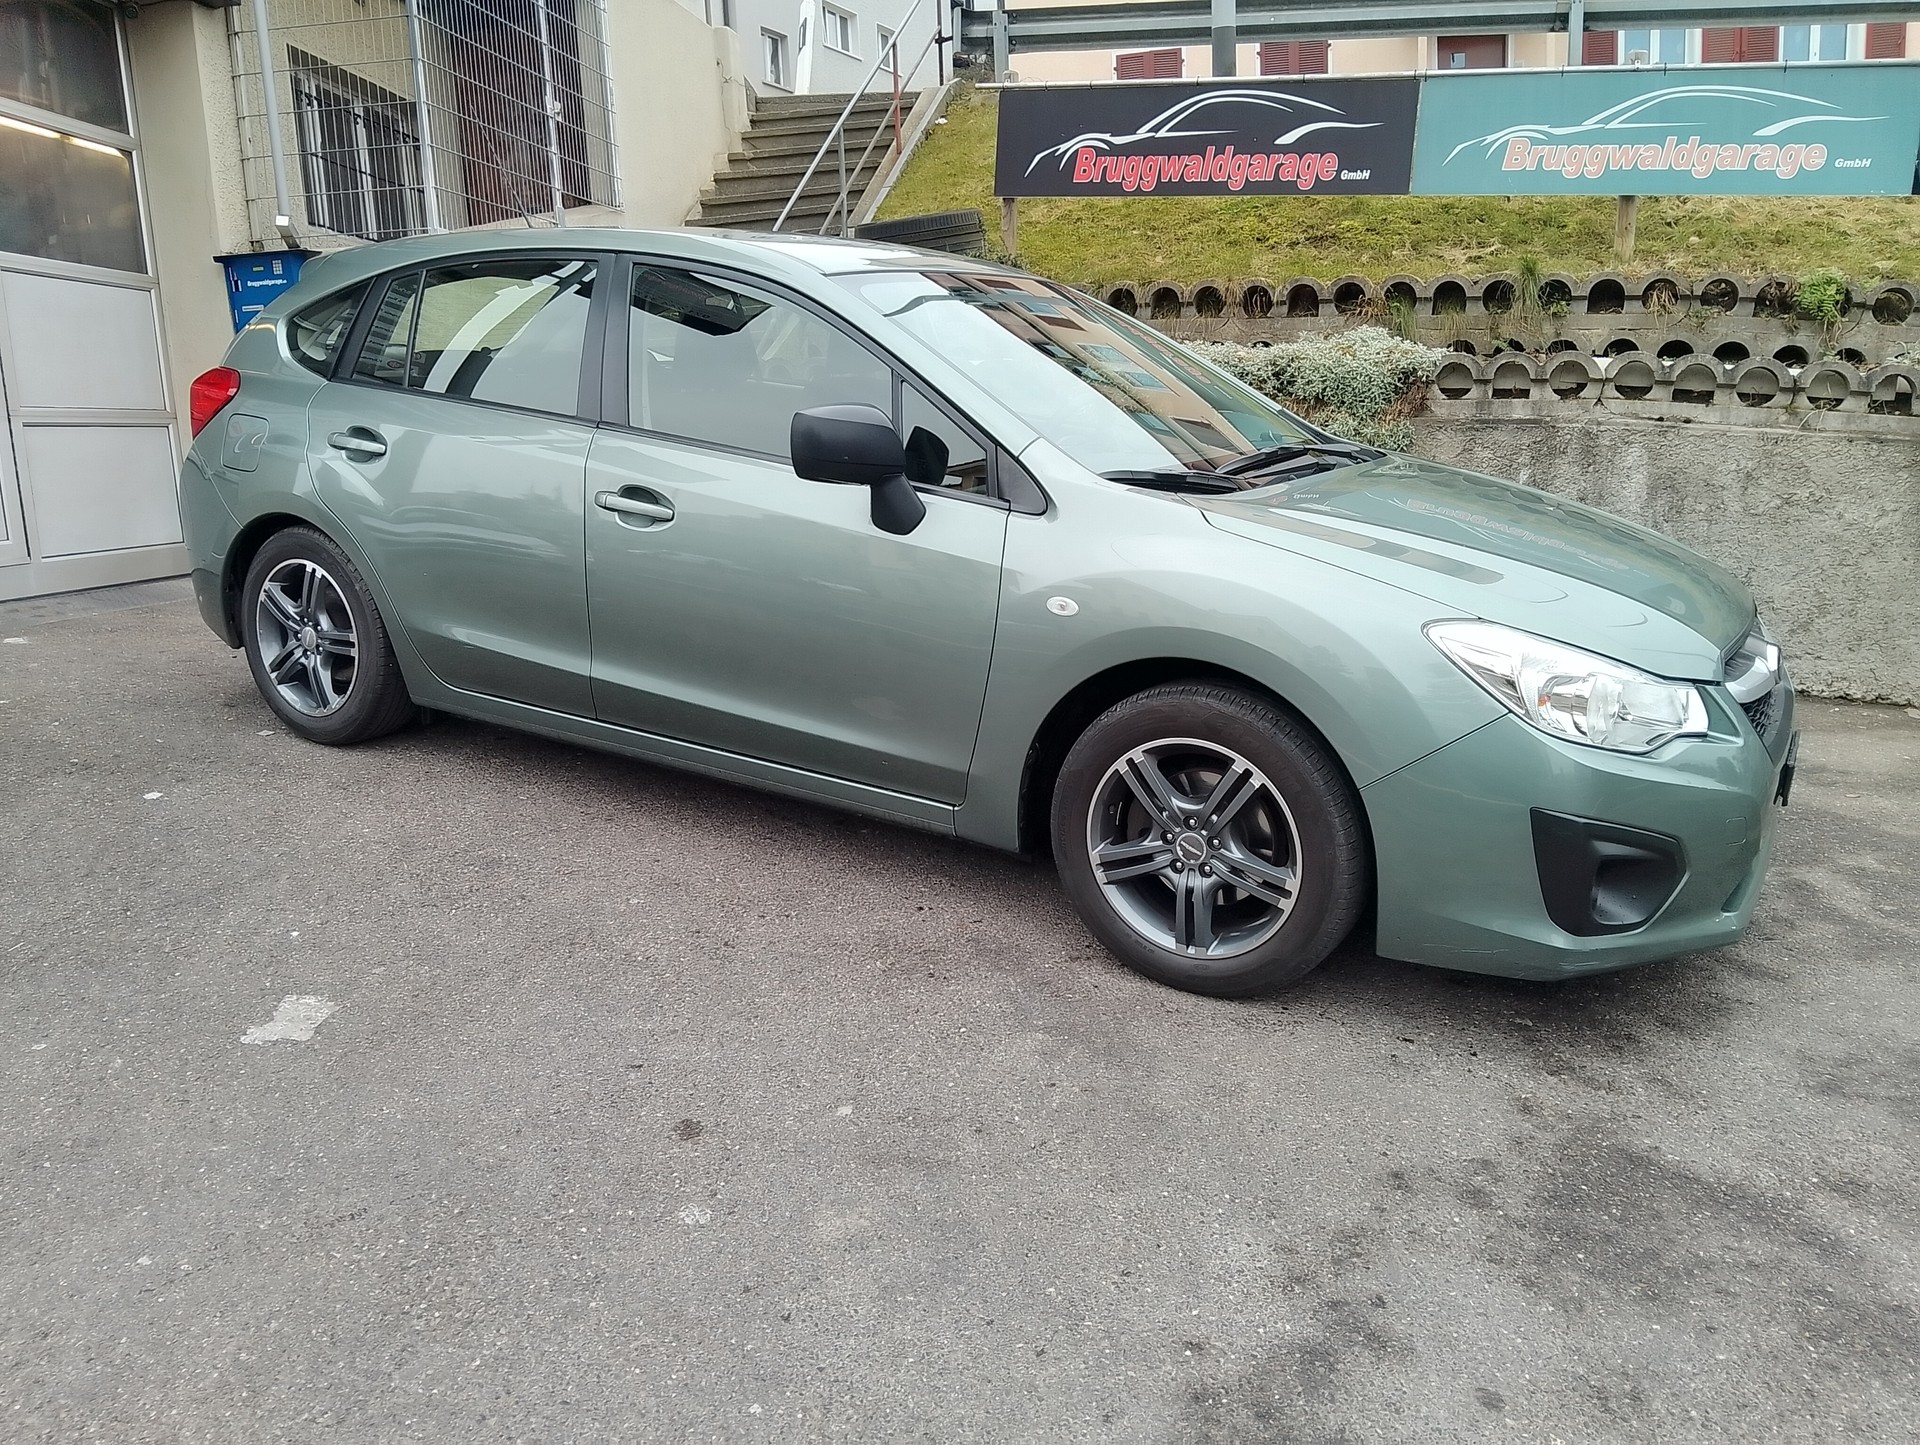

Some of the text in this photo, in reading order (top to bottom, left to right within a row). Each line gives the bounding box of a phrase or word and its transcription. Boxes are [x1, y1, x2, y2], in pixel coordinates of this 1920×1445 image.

[1073, 145, 1371, 191] Bruggwaldgarage GmbH
[1501, 135, 1872, 179] Bruggwaldgarage GmbH
